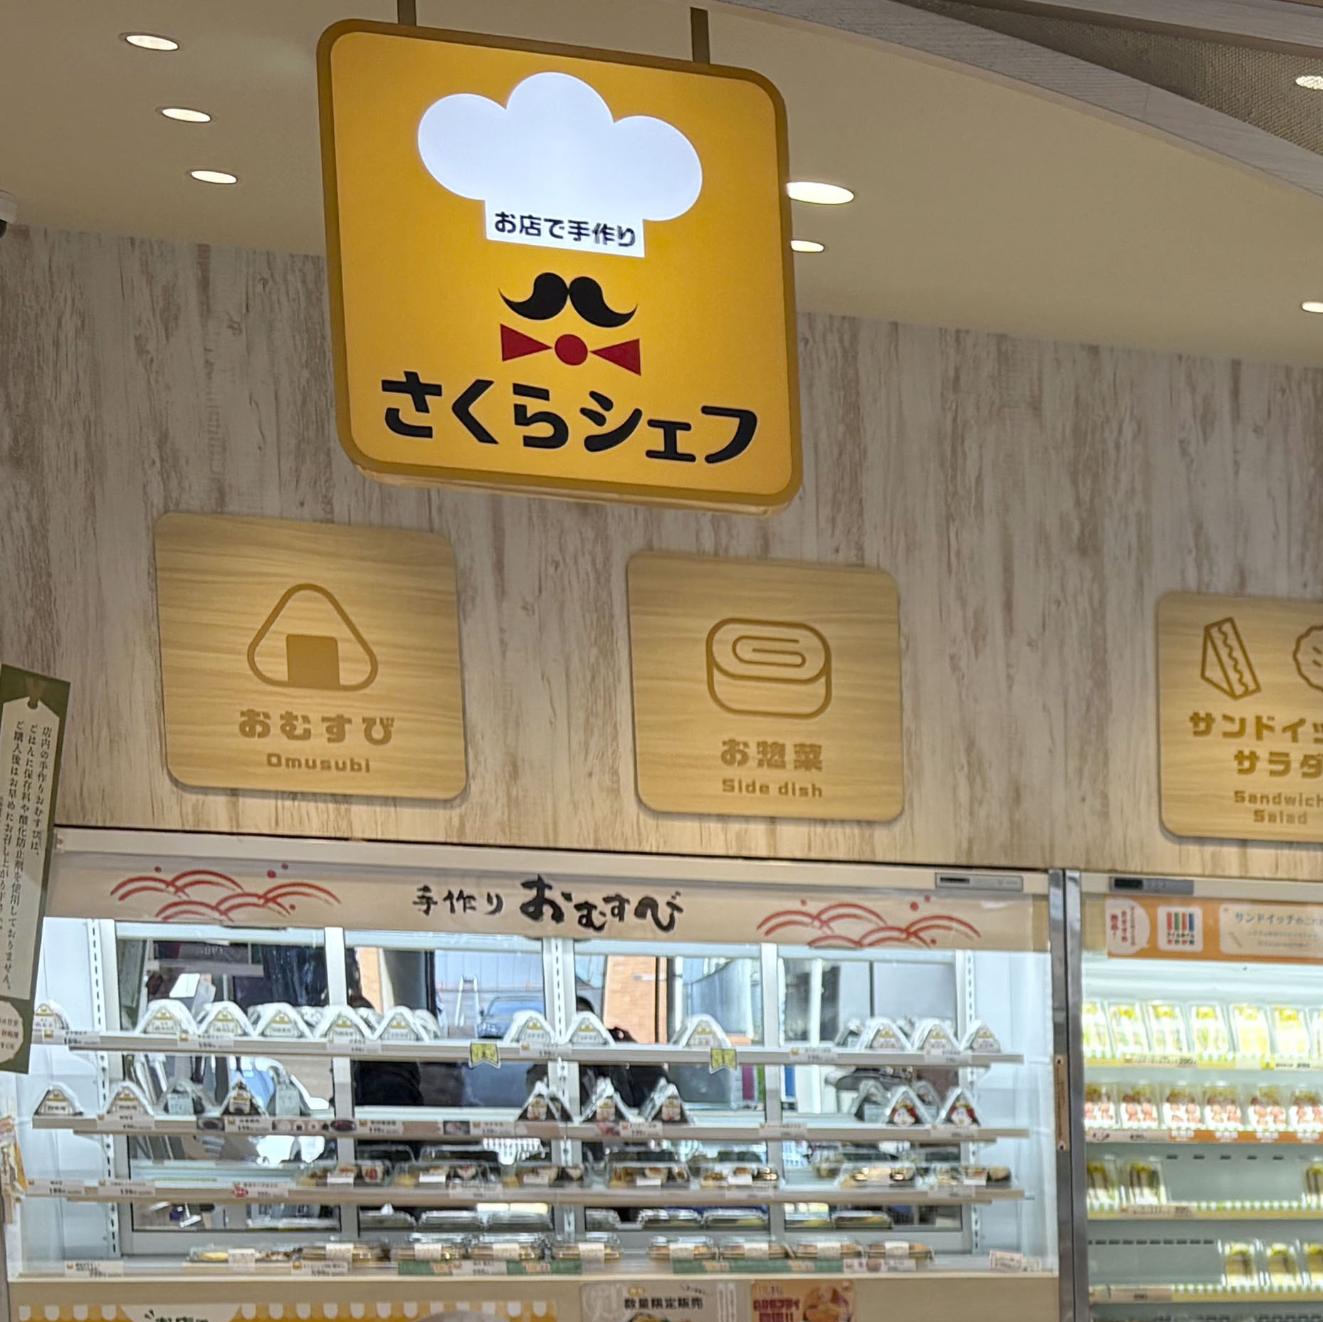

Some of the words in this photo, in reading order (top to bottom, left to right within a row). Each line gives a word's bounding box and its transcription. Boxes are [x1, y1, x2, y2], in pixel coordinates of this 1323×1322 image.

[494, 211, 637, 248] お店で手作り
[381, 371, 759, 465] さくらシェフ
[238, 709, 395, 745] おむすび
[266, 752, 371, 773] Omusubi
[721, 738, 824, 772] お惣菜
[721, 777, 762, 797] Side
[768, 778, 823, 799] dish
[1253, 808, 1308, 825] Salad
[412, 884, 504, 916] 手作り
[519, 874, 684, 932] おむすび
